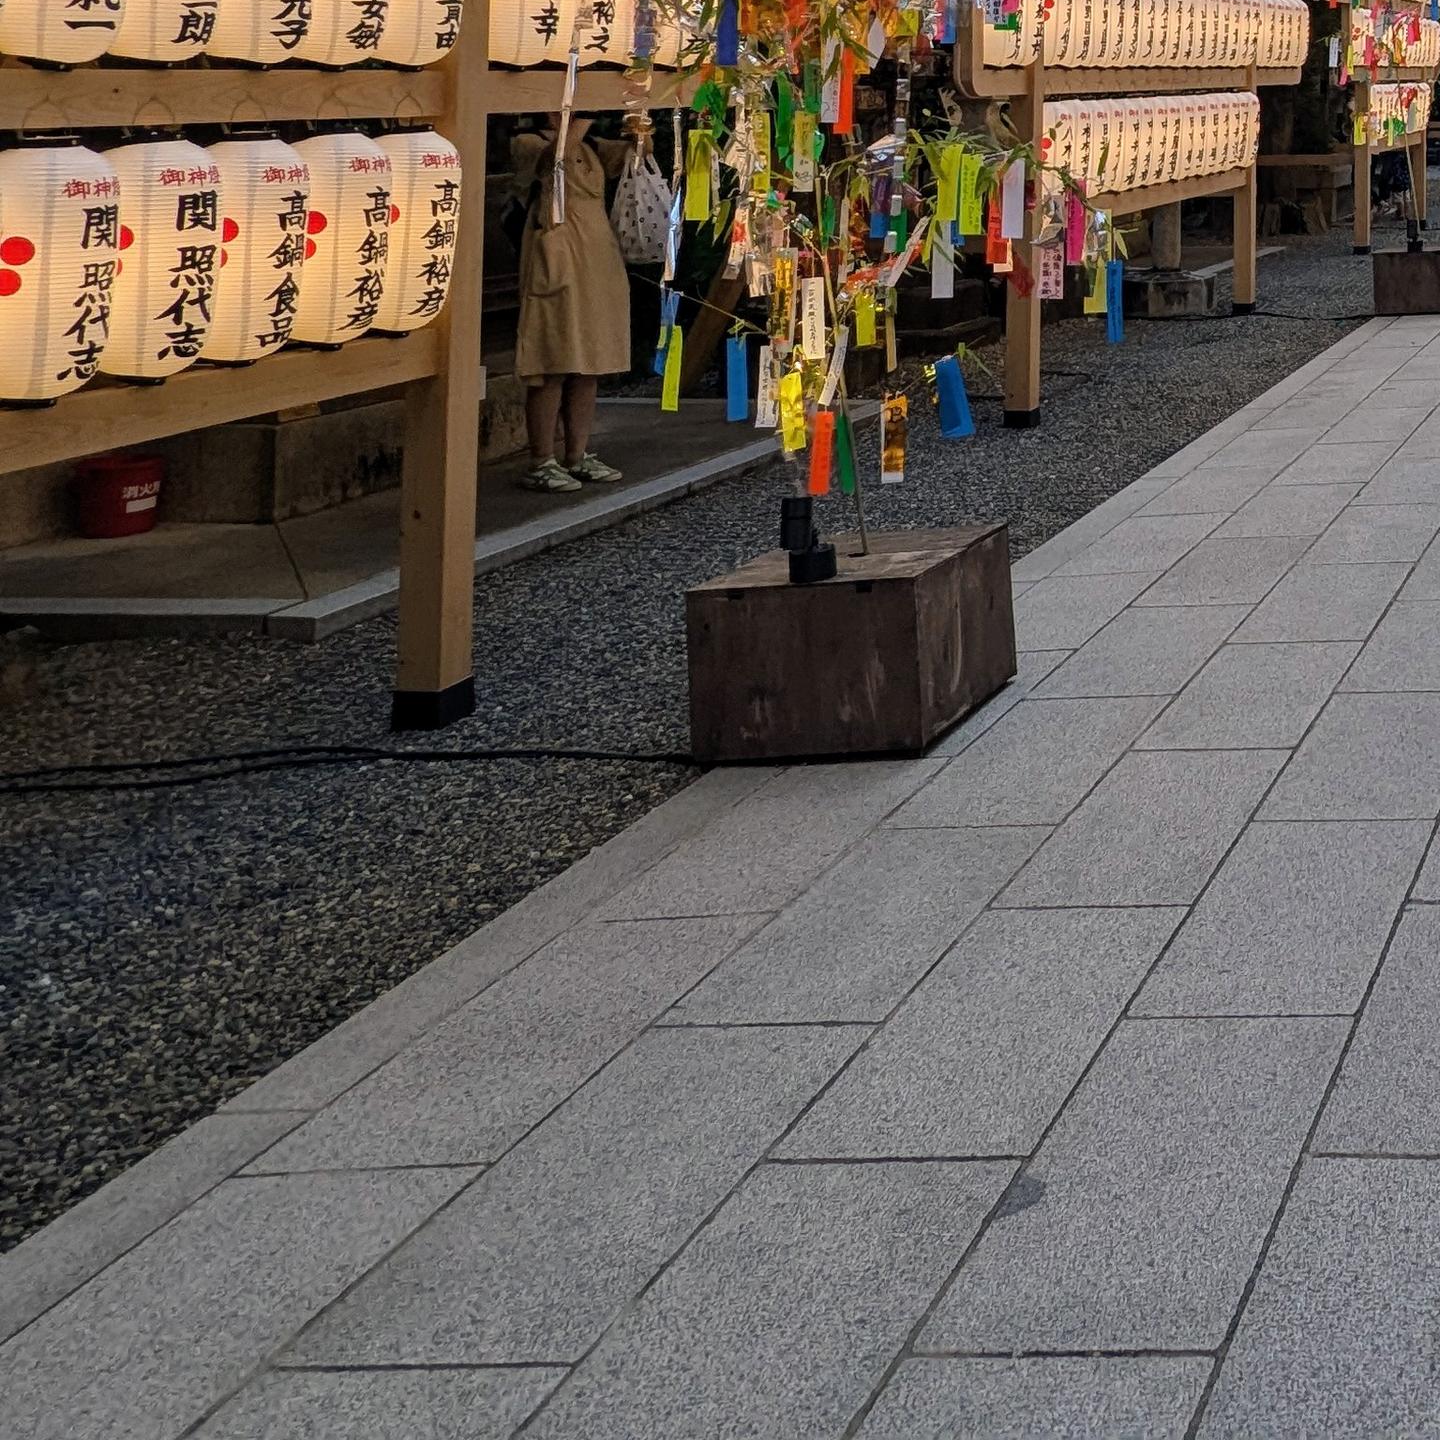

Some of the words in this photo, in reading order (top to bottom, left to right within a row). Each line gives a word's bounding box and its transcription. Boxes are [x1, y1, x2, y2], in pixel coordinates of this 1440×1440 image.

[57, 203, 120, 381] 関照代志
[153, 189, 219, 360] 関照代志
